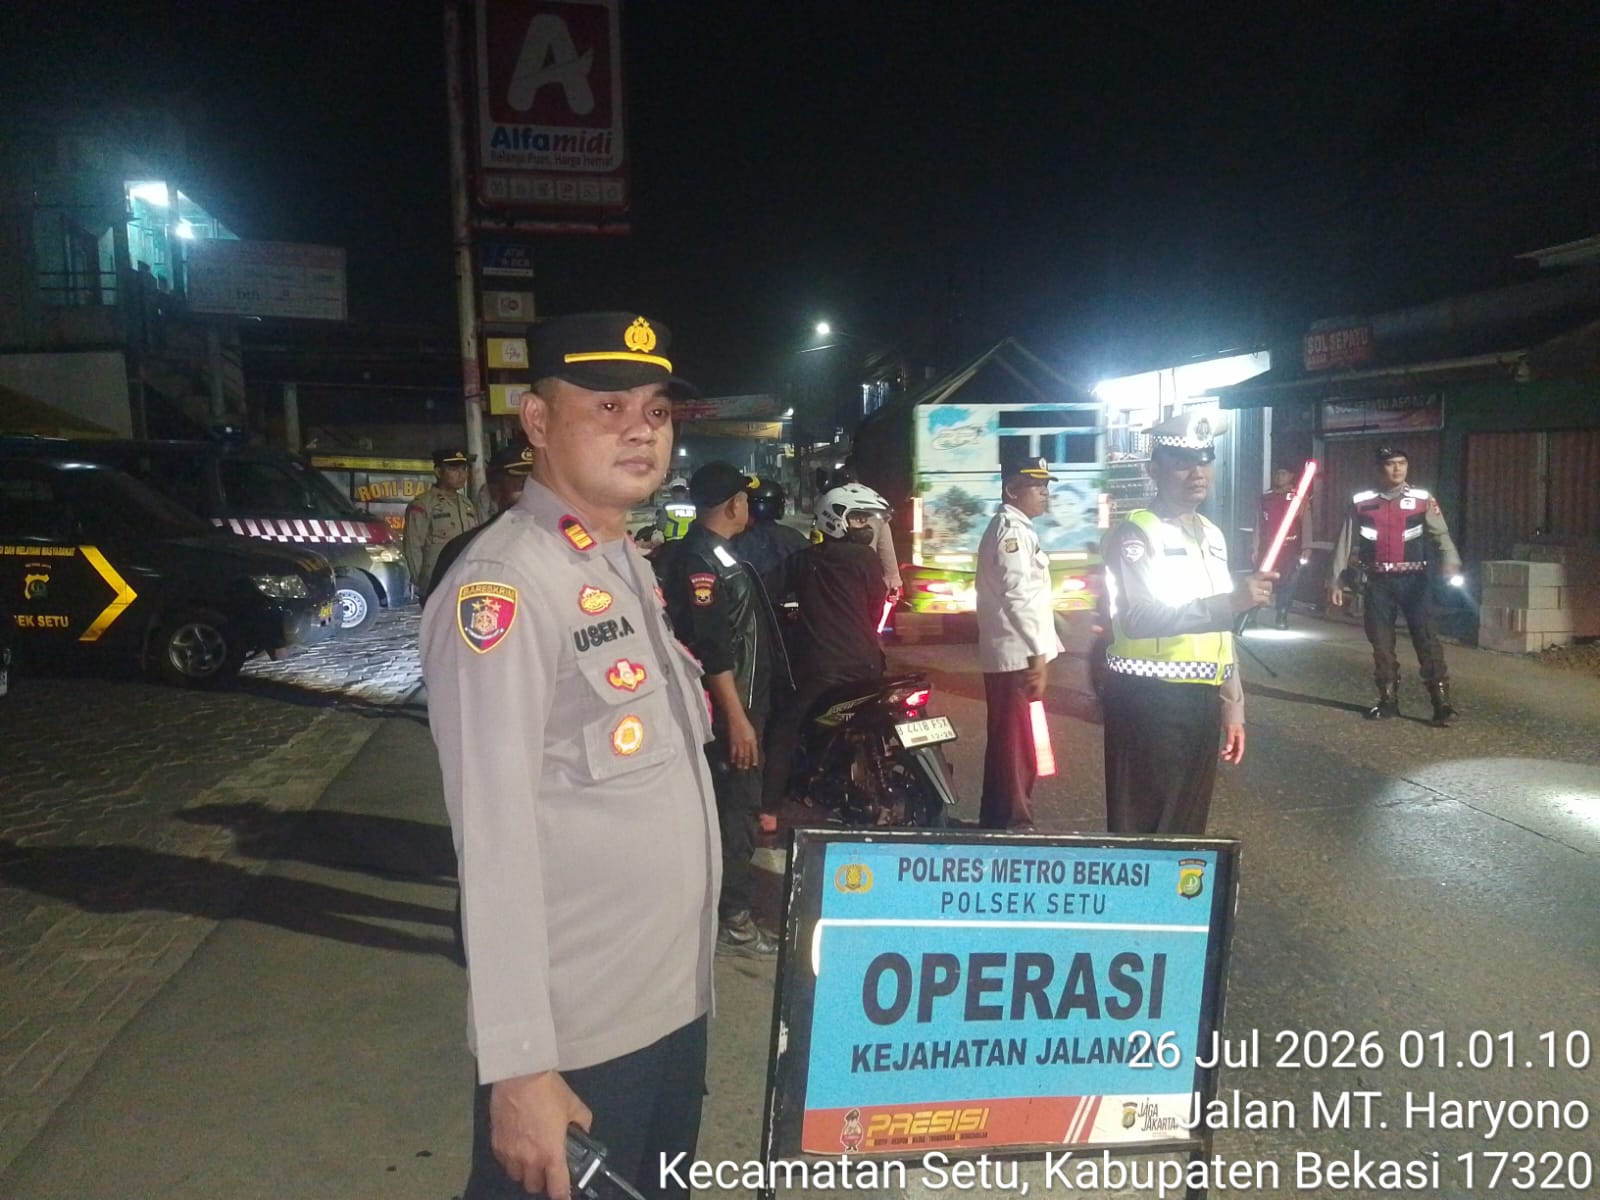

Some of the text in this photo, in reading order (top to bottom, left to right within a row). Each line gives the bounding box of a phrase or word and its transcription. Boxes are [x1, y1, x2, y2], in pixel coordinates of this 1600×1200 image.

[491, 126, 612, 154] Alfamidi
[1307, 327, 1369, 355] SOL SEPATU
[358, 479, 398, 502] ROTI
[462, 584, 515, 598] BARESKRIM
[13, 614, 69, 628] EK SETU
[573, 615, 635, 652] USEP.A
[898, 857, 1150, 887] POLRES METRO BEKASI
[941, 892, 1106, 915] POLSEK SETU
[862, 952, 1167, 1026] OPERASI
[851, 1038, 1028, 1073] KEJAHATAN
[866, 1107, 991, 1136] PRESISI
[1137, 1098, 1159, 1119] JAGA
